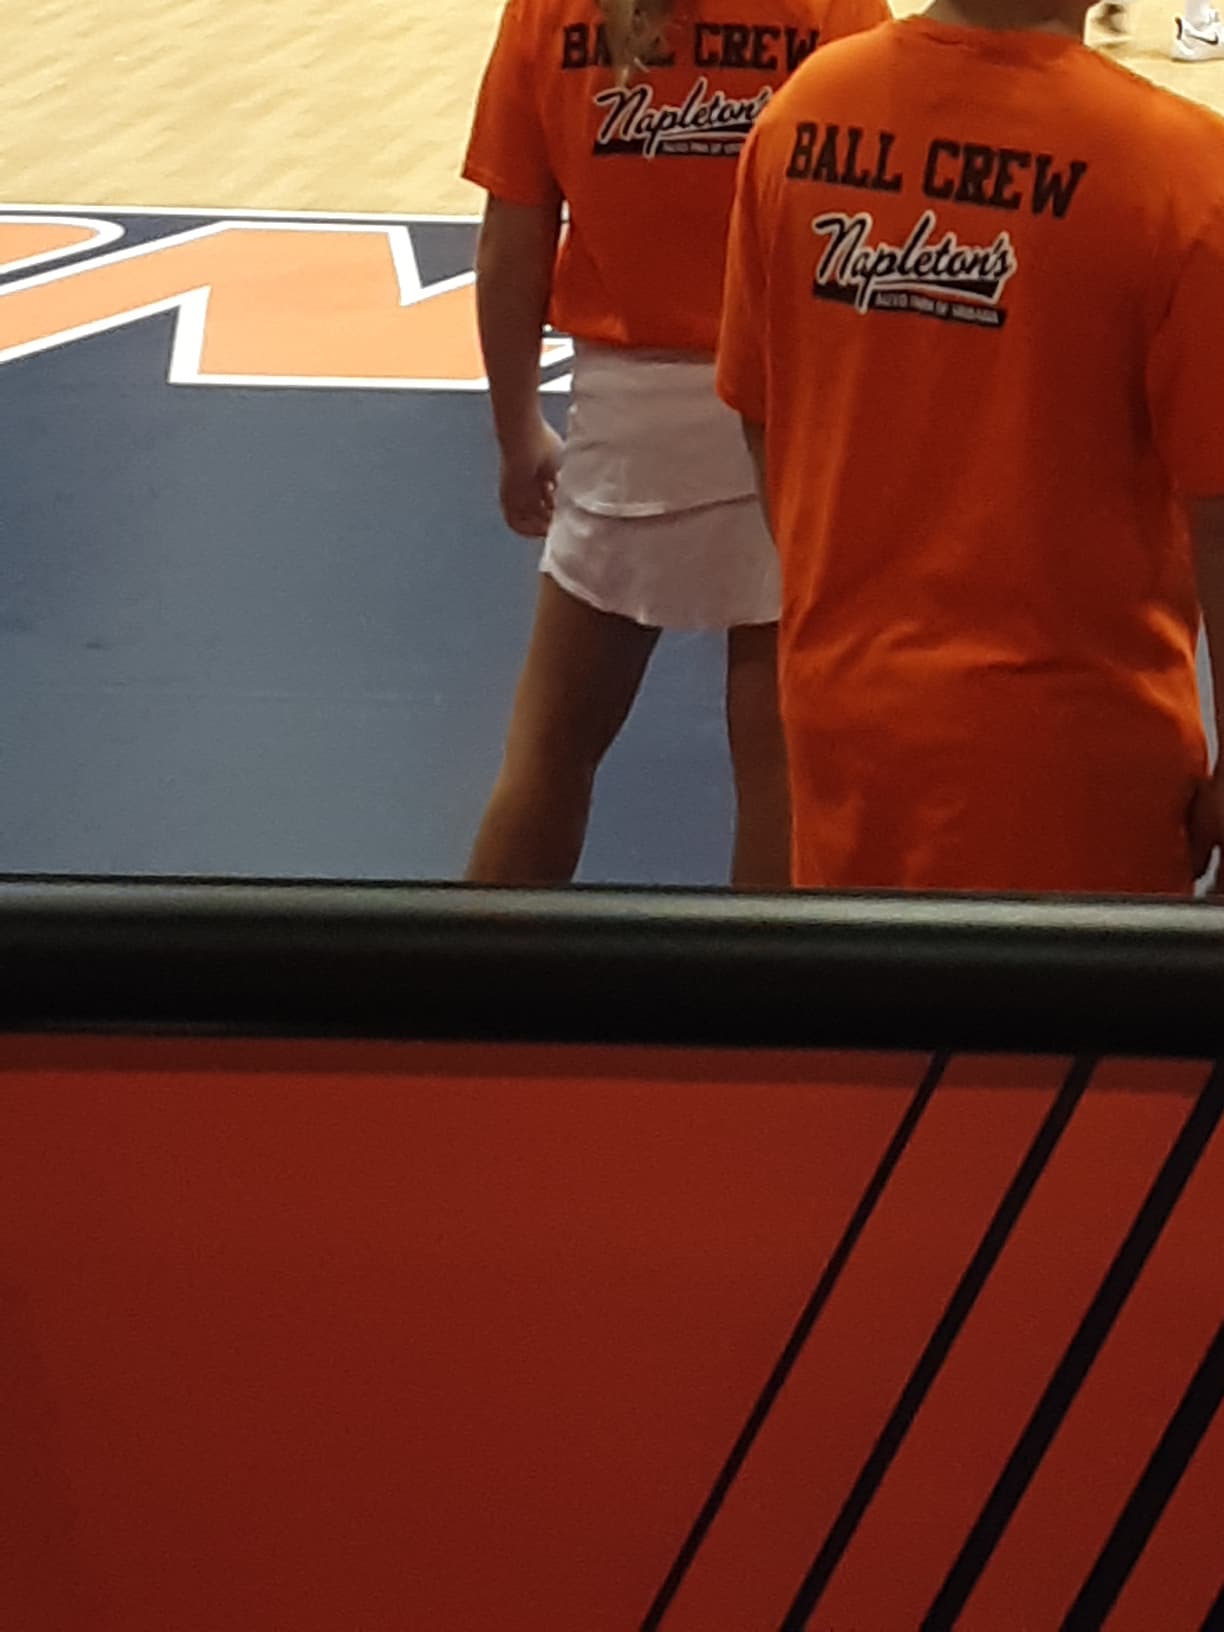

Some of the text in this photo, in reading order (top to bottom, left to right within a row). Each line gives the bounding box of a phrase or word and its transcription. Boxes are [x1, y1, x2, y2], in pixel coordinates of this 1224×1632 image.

[694, 23, 820, 71] CREW
[786, 121, 1088, 219] BALL CREW
[812, 210, 1018, 315] Napleton's
